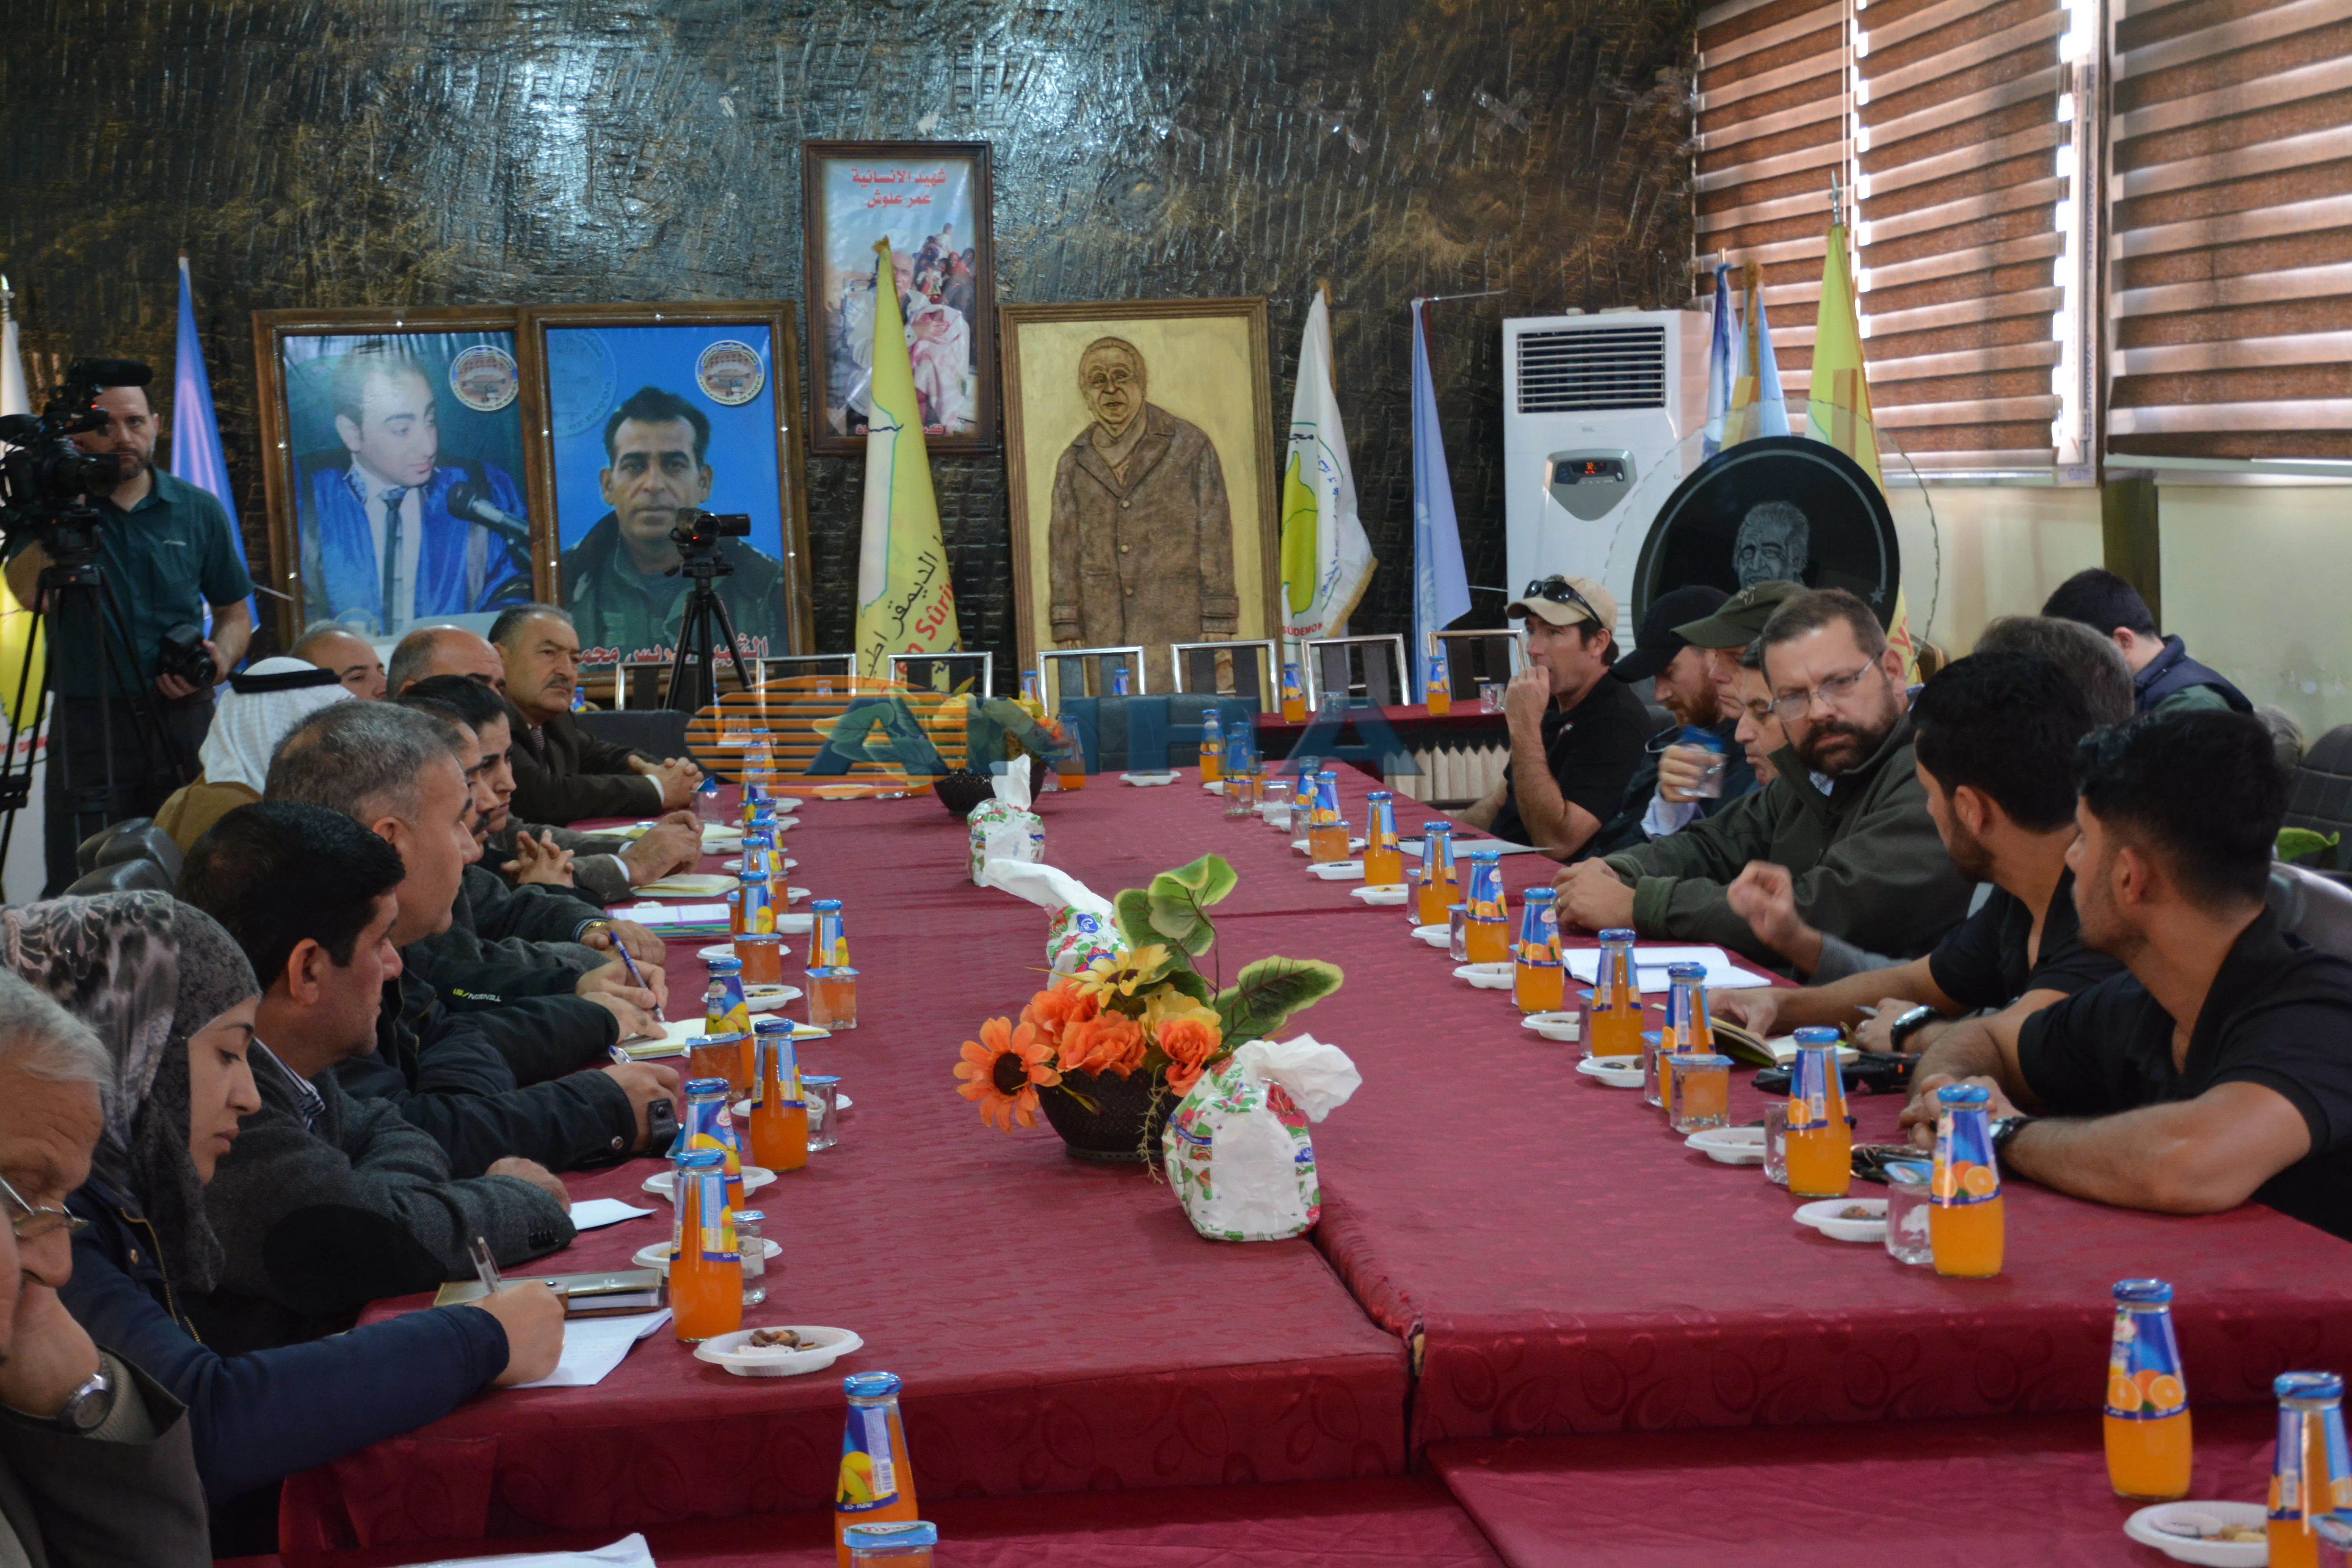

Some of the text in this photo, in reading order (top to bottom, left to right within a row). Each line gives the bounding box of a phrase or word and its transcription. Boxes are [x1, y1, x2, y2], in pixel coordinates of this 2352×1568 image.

[851, 168, 946, 187] شهيد الانسانية
[867, 189, 931, 208] عمر علوش
[577, 646, 621, 666] محم
[711, 632, 768, 667] الشهي
